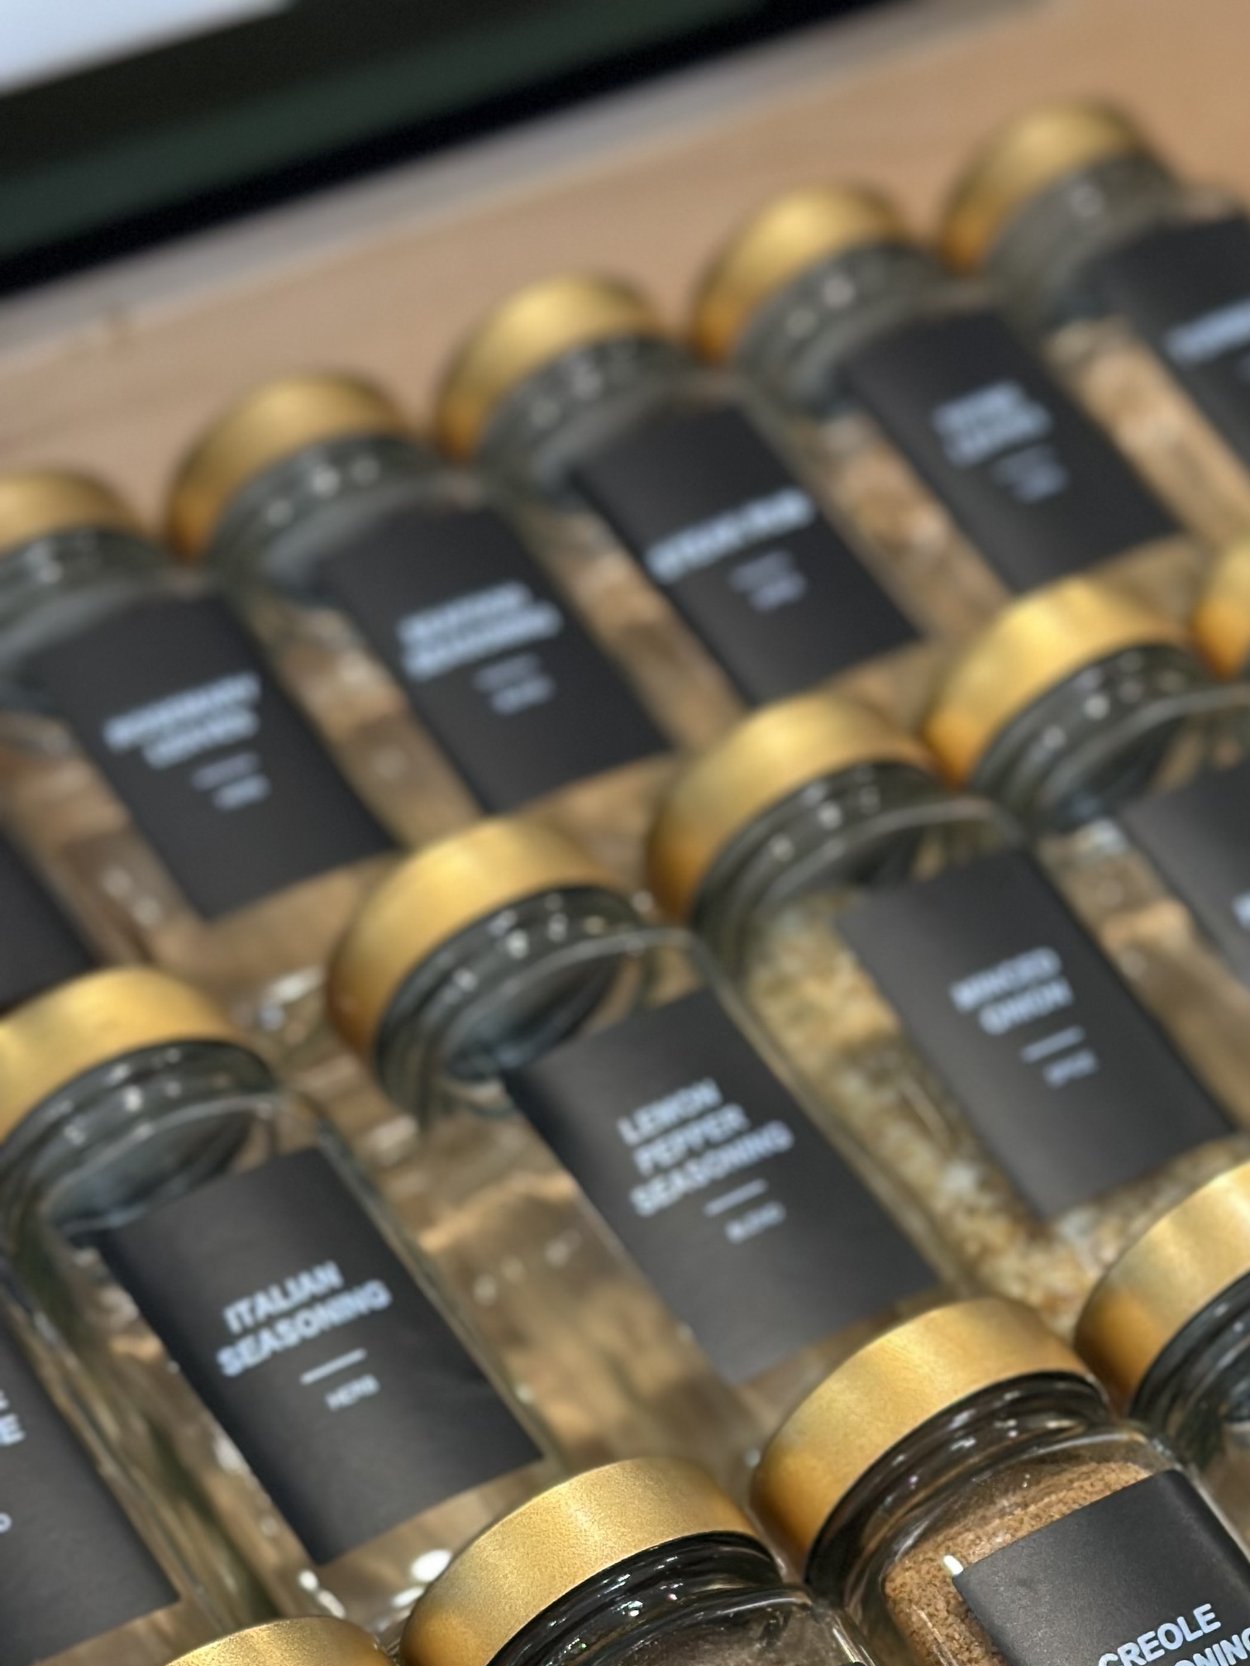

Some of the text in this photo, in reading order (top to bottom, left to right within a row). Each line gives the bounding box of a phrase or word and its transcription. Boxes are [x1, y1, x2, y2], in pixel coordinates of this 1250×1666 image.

[631, 1121, 794, 1217] SEASONING
[217, 1280, 391, 1376] SEASONING
[224, 1261, 343, 1333] ITALIAN
